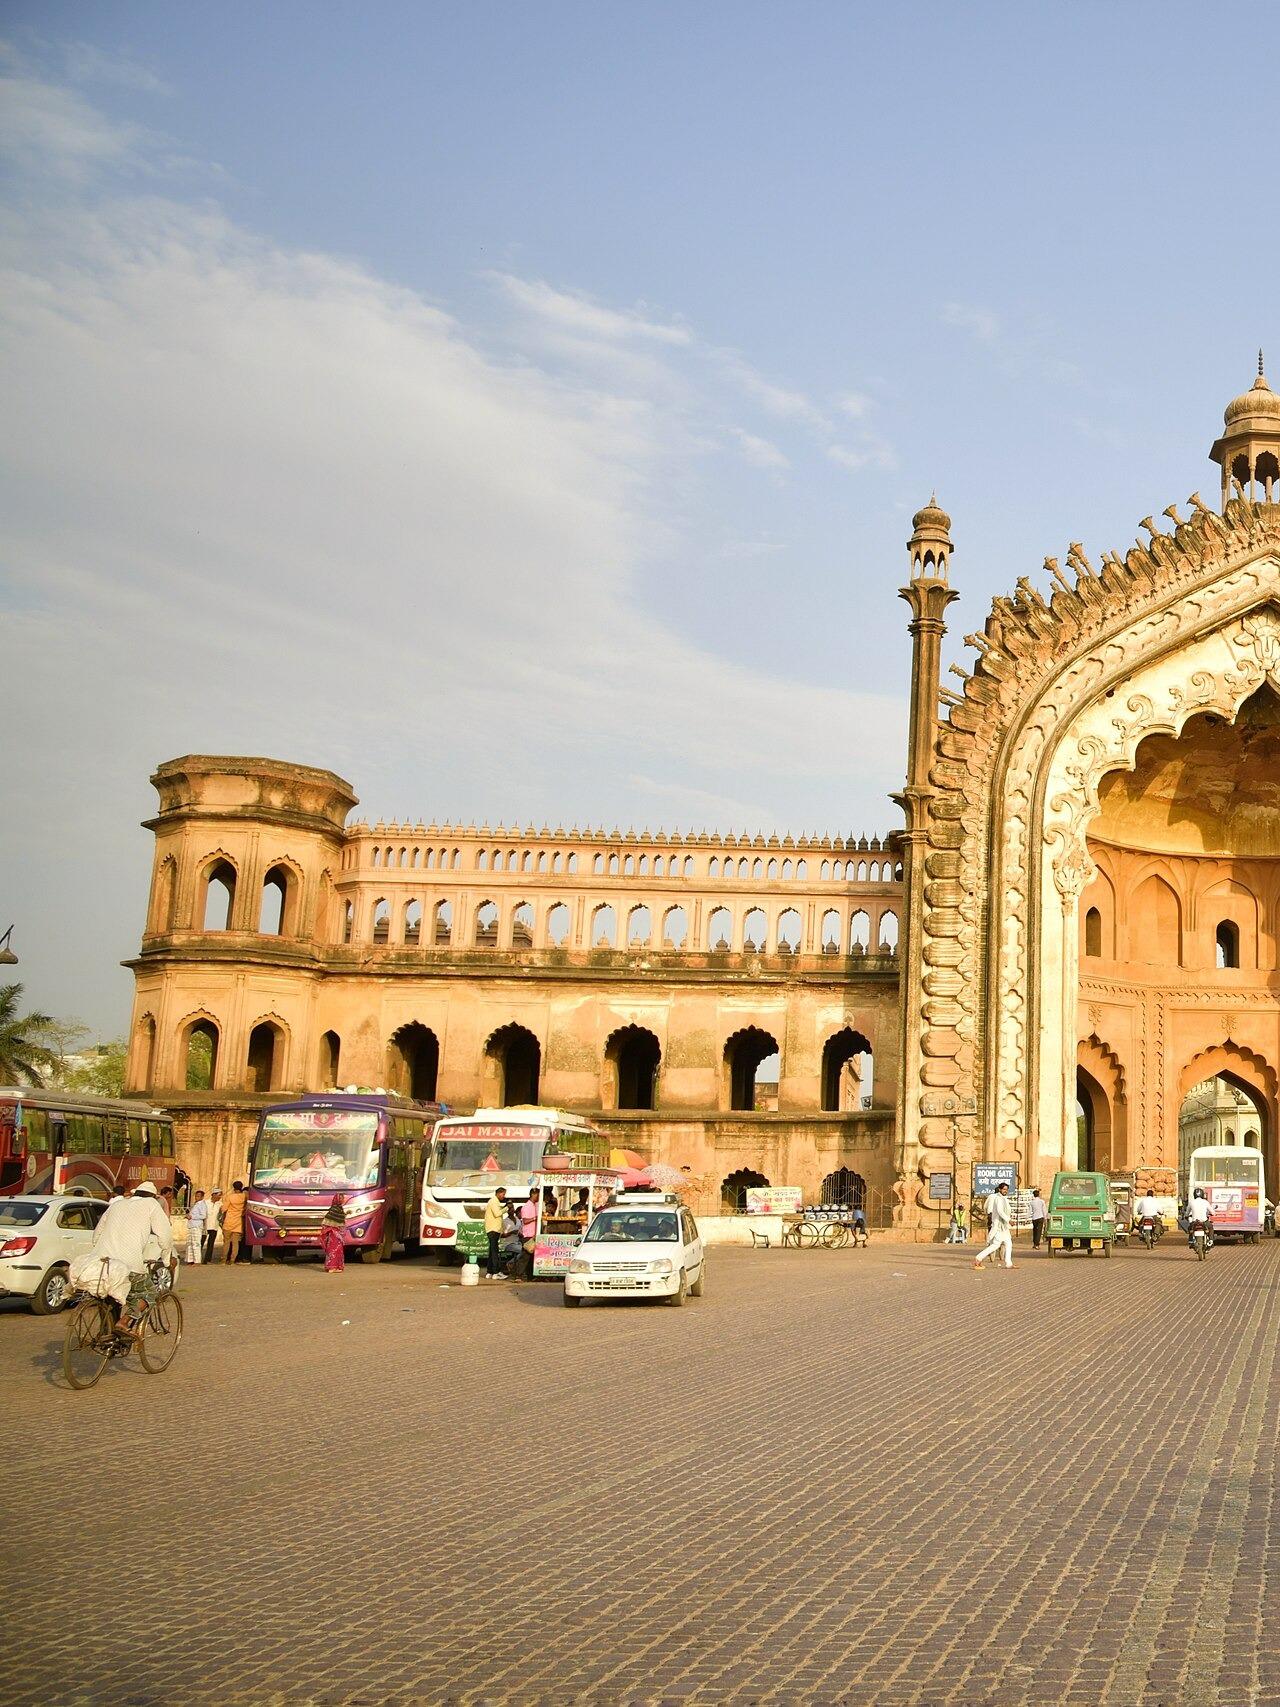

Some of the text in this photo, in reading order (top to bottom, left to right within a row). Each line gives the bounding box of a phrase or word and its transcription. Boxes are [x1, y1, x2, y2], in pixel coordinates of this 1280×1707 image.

[442, 1126, 474, 1136] JAI
[478, 1126, 524, 1137] MATA
[977, 1169, 1013, 1178] ROOMI GATE
